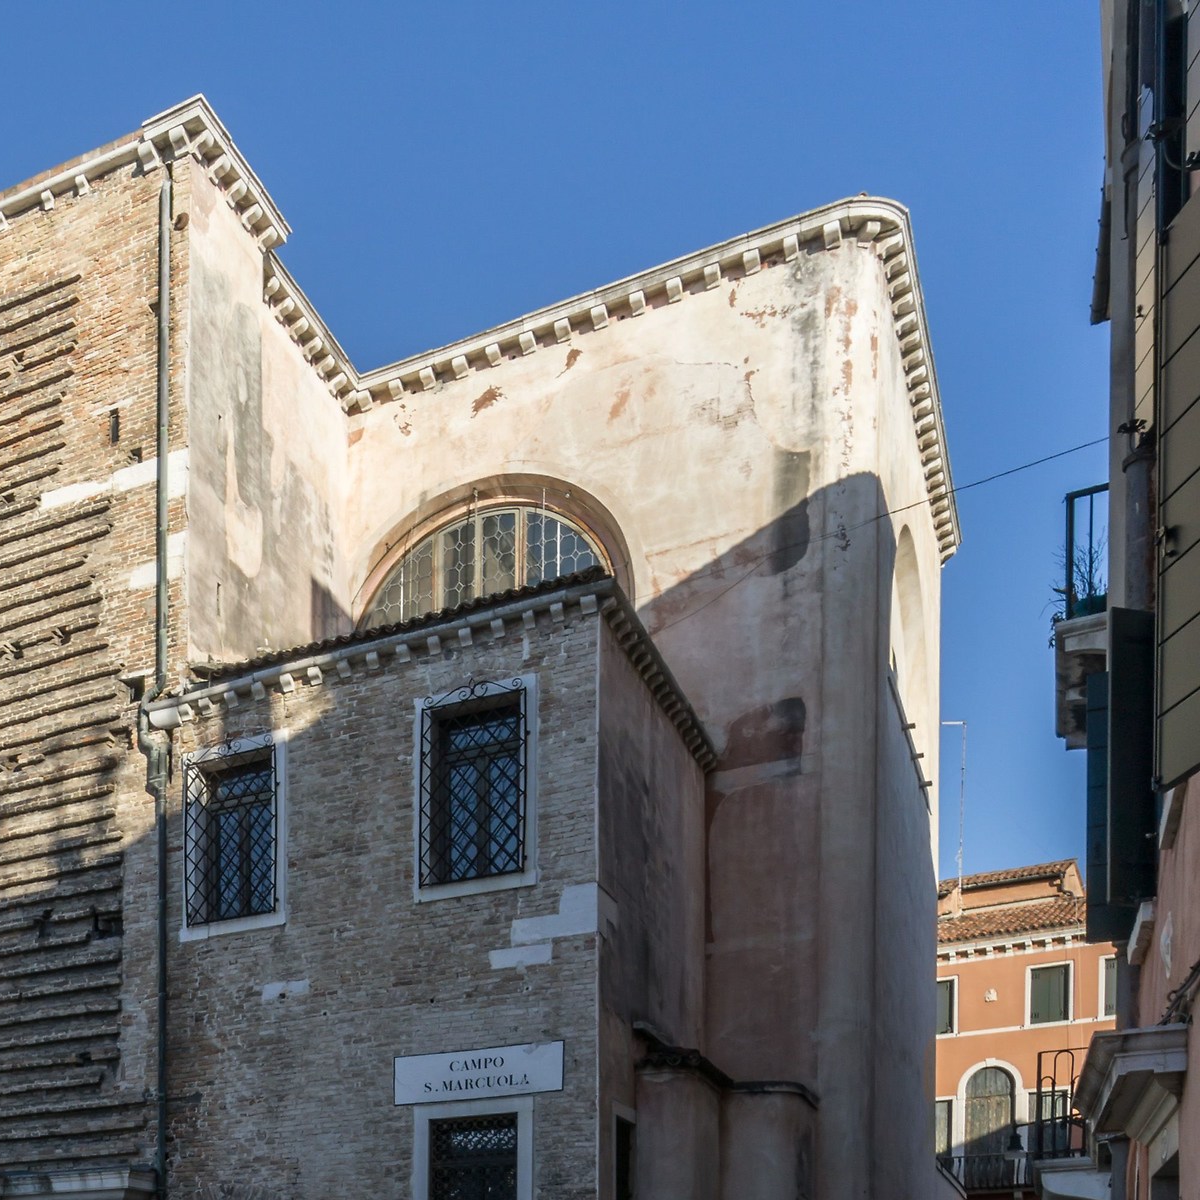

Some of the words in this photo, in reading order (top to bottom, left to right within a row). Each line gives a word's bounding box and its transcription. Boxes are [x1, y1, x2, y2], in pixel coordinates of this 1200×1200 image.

[450, 1056, 504, 1072] CAMPO
[424, 1082, 439, 1093] S.
[442, 1074, 529, 1091] MARCUOLA
